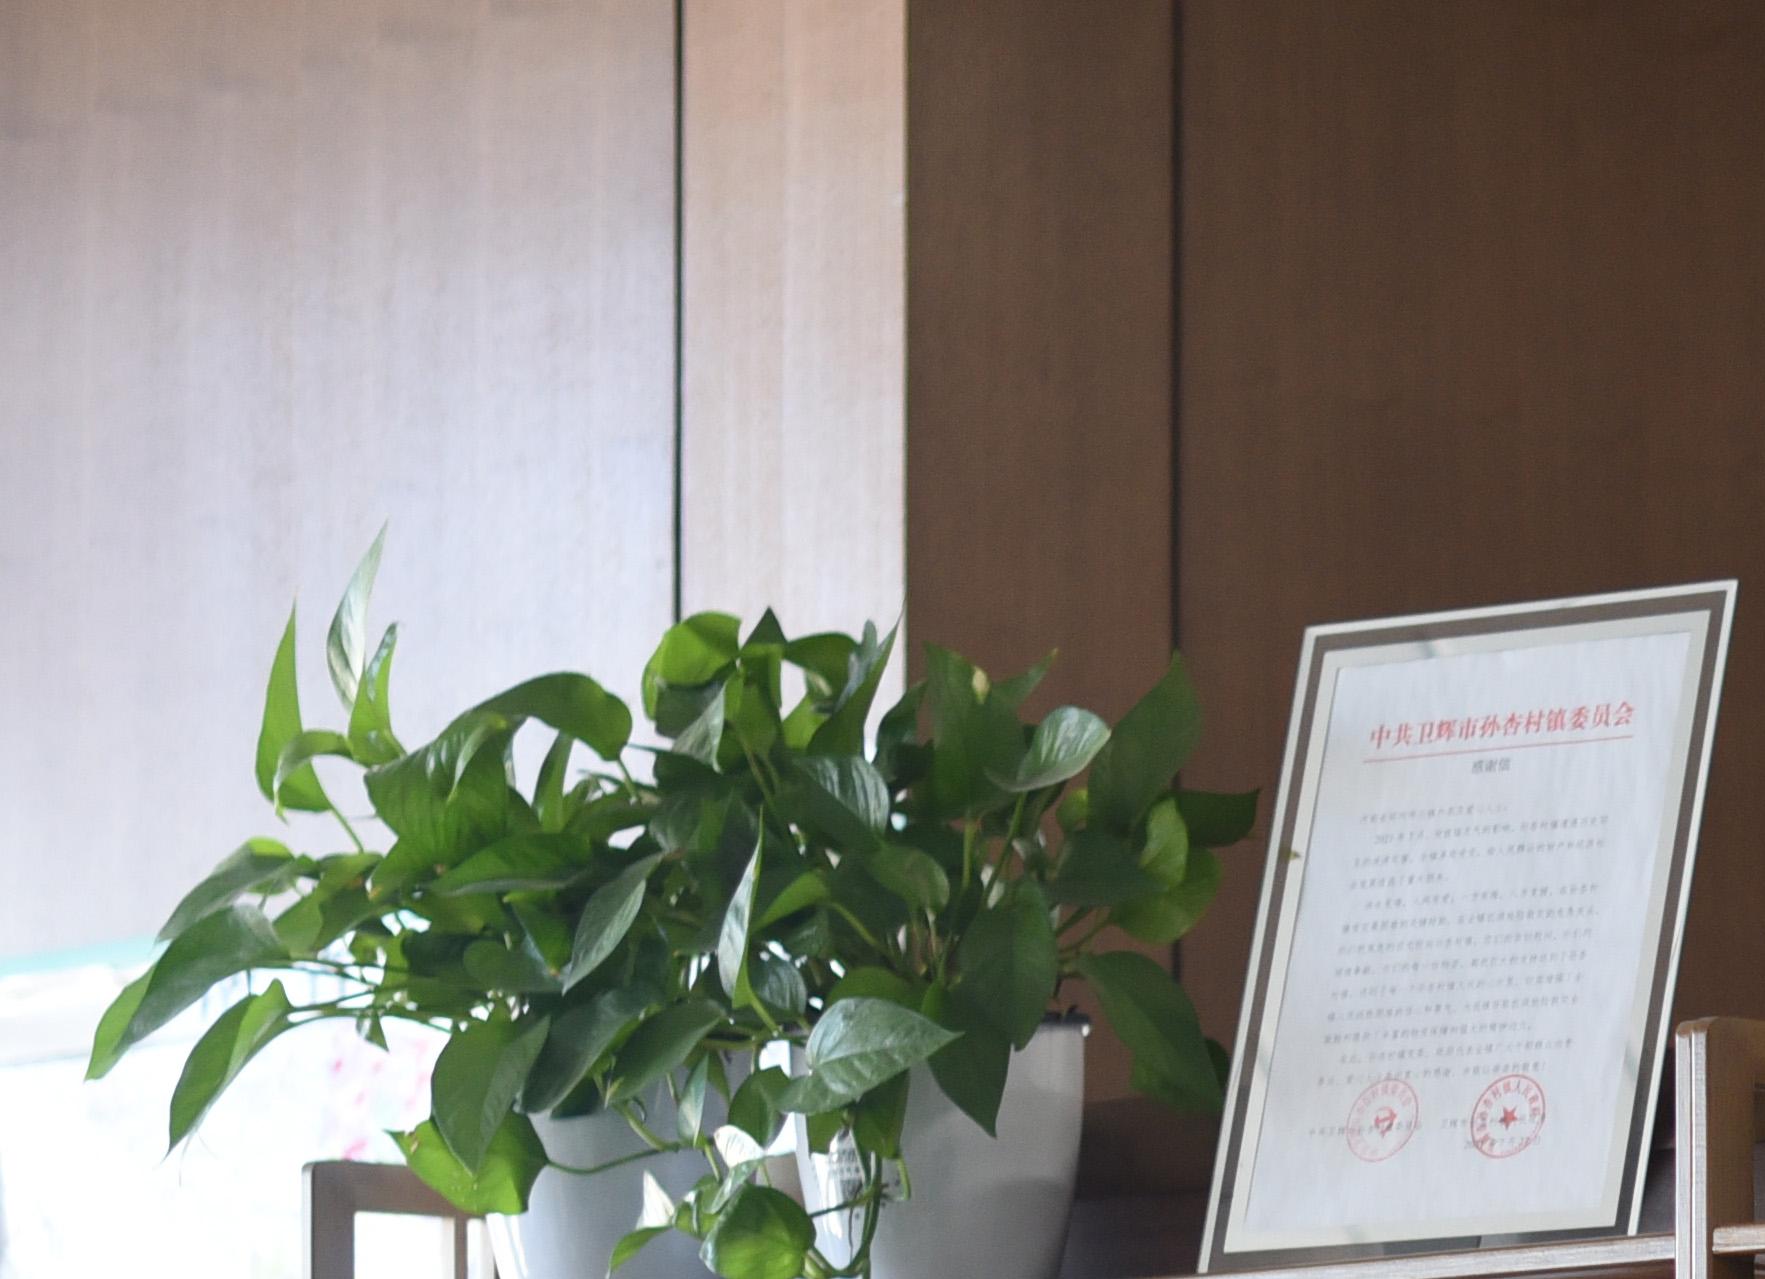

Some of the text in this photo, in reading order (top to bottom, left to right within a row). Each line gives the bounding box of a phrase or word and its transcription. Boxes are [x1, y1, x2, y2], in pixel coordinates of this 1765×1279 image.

[1368, 701, 1635, 748] 中共卫辉市孙杏村镇委员会
